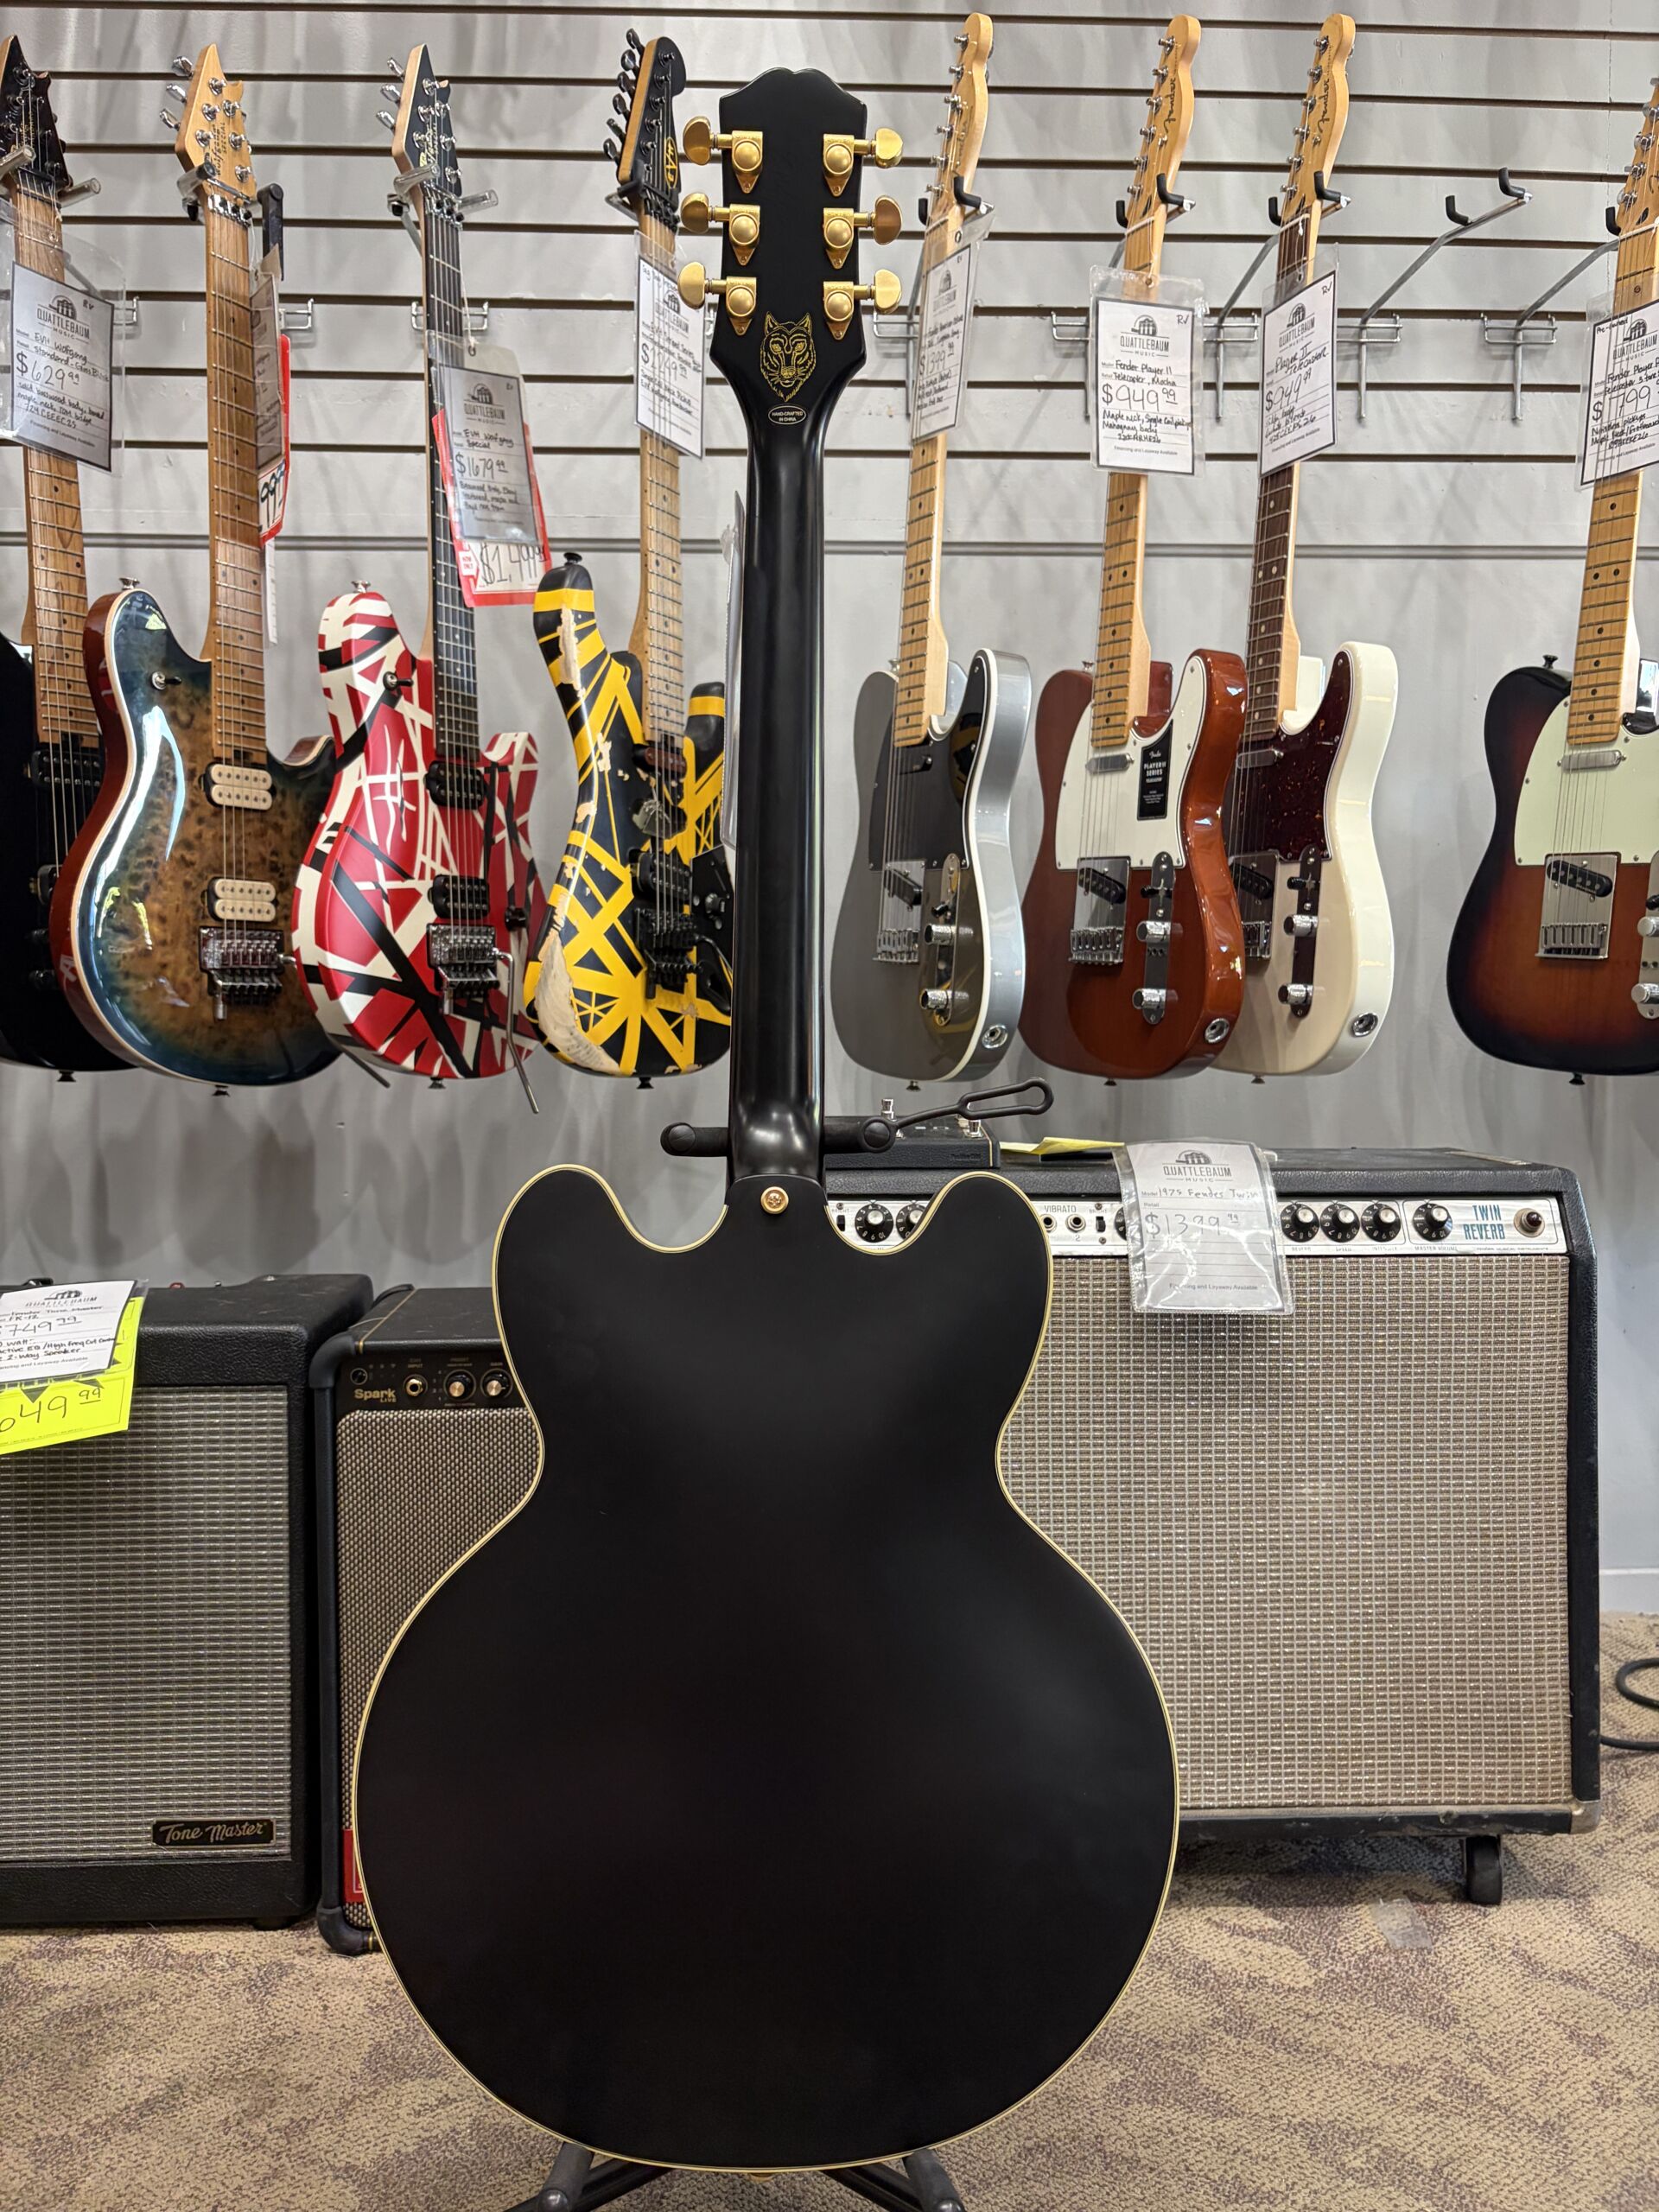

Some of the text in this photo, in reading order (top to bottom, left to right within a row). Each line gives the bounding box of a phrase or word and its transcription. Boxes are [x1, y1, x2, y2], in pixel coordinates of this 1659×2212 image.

[1164, 77, 1176, 133] Fender
[1317, 79, 1331, 133] Fender
[37, 308, 90, 339] QUATTLEBAUM
[1280, 316, 1315, 347] QUATTLEBAUM
[53, 327, 74, 340] MUSIC
[1120, 335, 1169, 353] QUATTLEBAUM
[1613, 334, 1657, 359] QUATTLEBAUM
[1116, 359, 1138, 371] Fender
[1141, 363, 1163, 378] Player
[1607, 369, 1630, 383] Fender
[1634, 361, 1653, 376] Player
[463, 403, 505, 420] QUATTLEBAUM
[1103, 410, 1125, 421] Maple
[1624, 412, 1646, 426] pickups
[455, 452, 494, 480] $1679
[1146, 768, 1163, 777] SERIES
[1163, 1166, 1232, 1177] QUATTLEBAUM
[1229, 1188, 1258, 1199] Twin
[1044, 1205, 1077, 1213] VIBRATO
[1472, 1205, 1502, 1221] TWIN
[1145, 1212, 1220, 1239] $1399
[1463, 1224, 1505, 1240] REVERB
[1074, 1233, 1081, 1242] 2
[79, 1388, 102, 1405] 99
[354, 1388, 397, 1400] Spark
[159, 1821, 263, 1844] Tone Master
